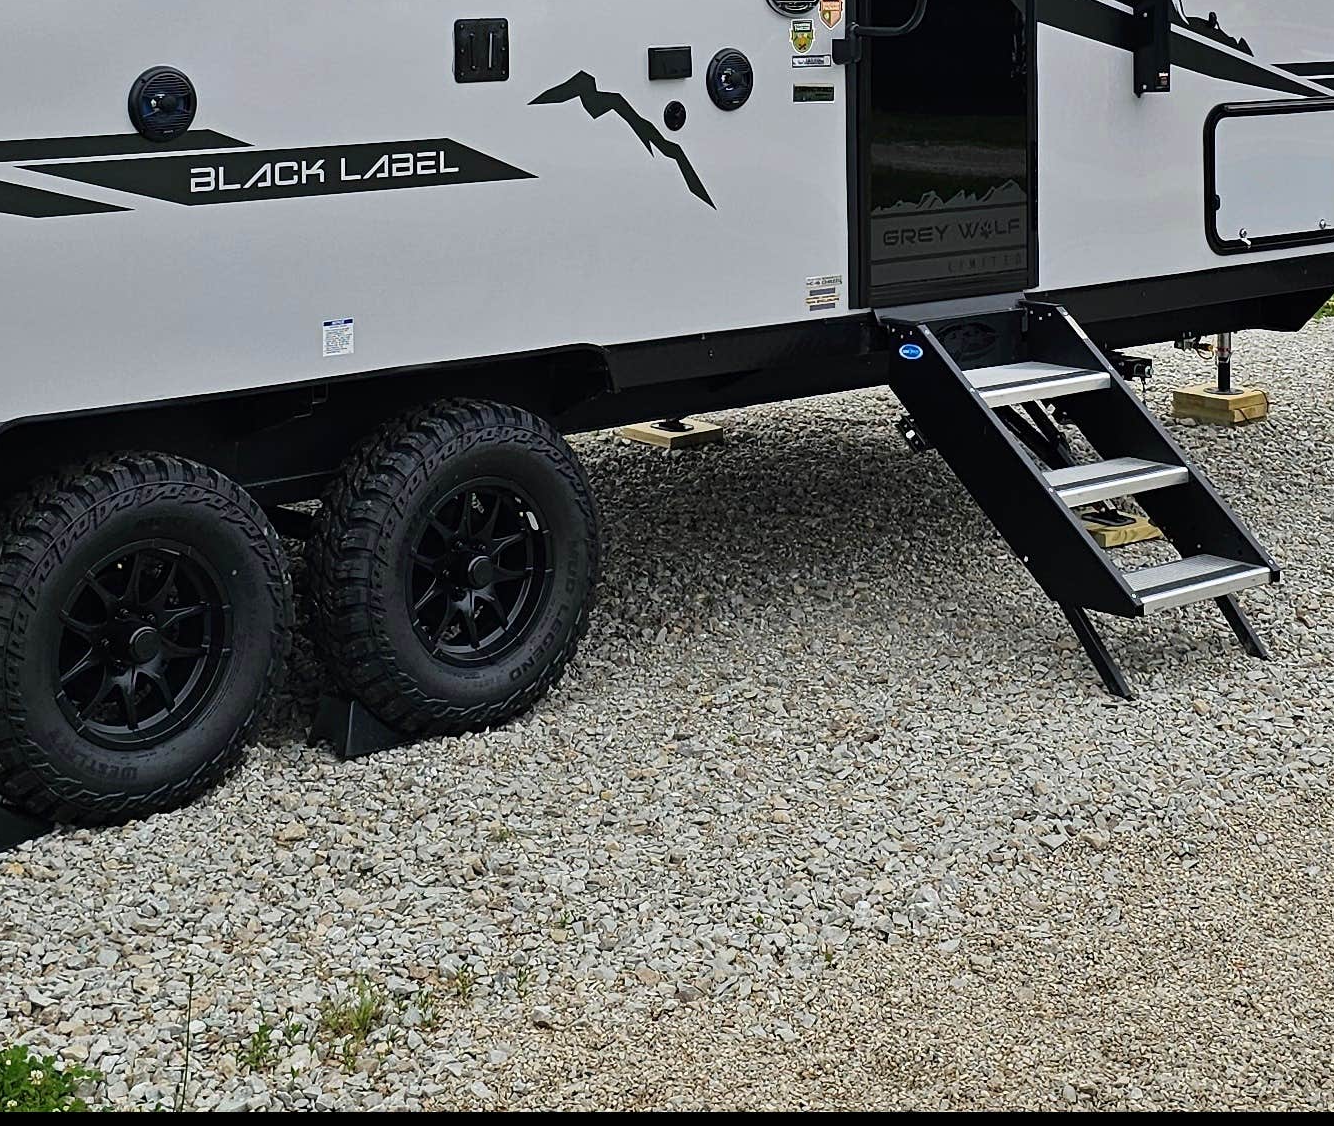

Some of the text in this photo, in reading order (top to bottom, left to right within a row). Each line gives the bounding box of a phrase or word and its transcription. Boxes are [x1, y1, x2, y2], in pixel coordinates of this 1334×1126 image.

[190, 151, 459, 192] BLACK LABEL
[883, 223, 950, 245] GREY
